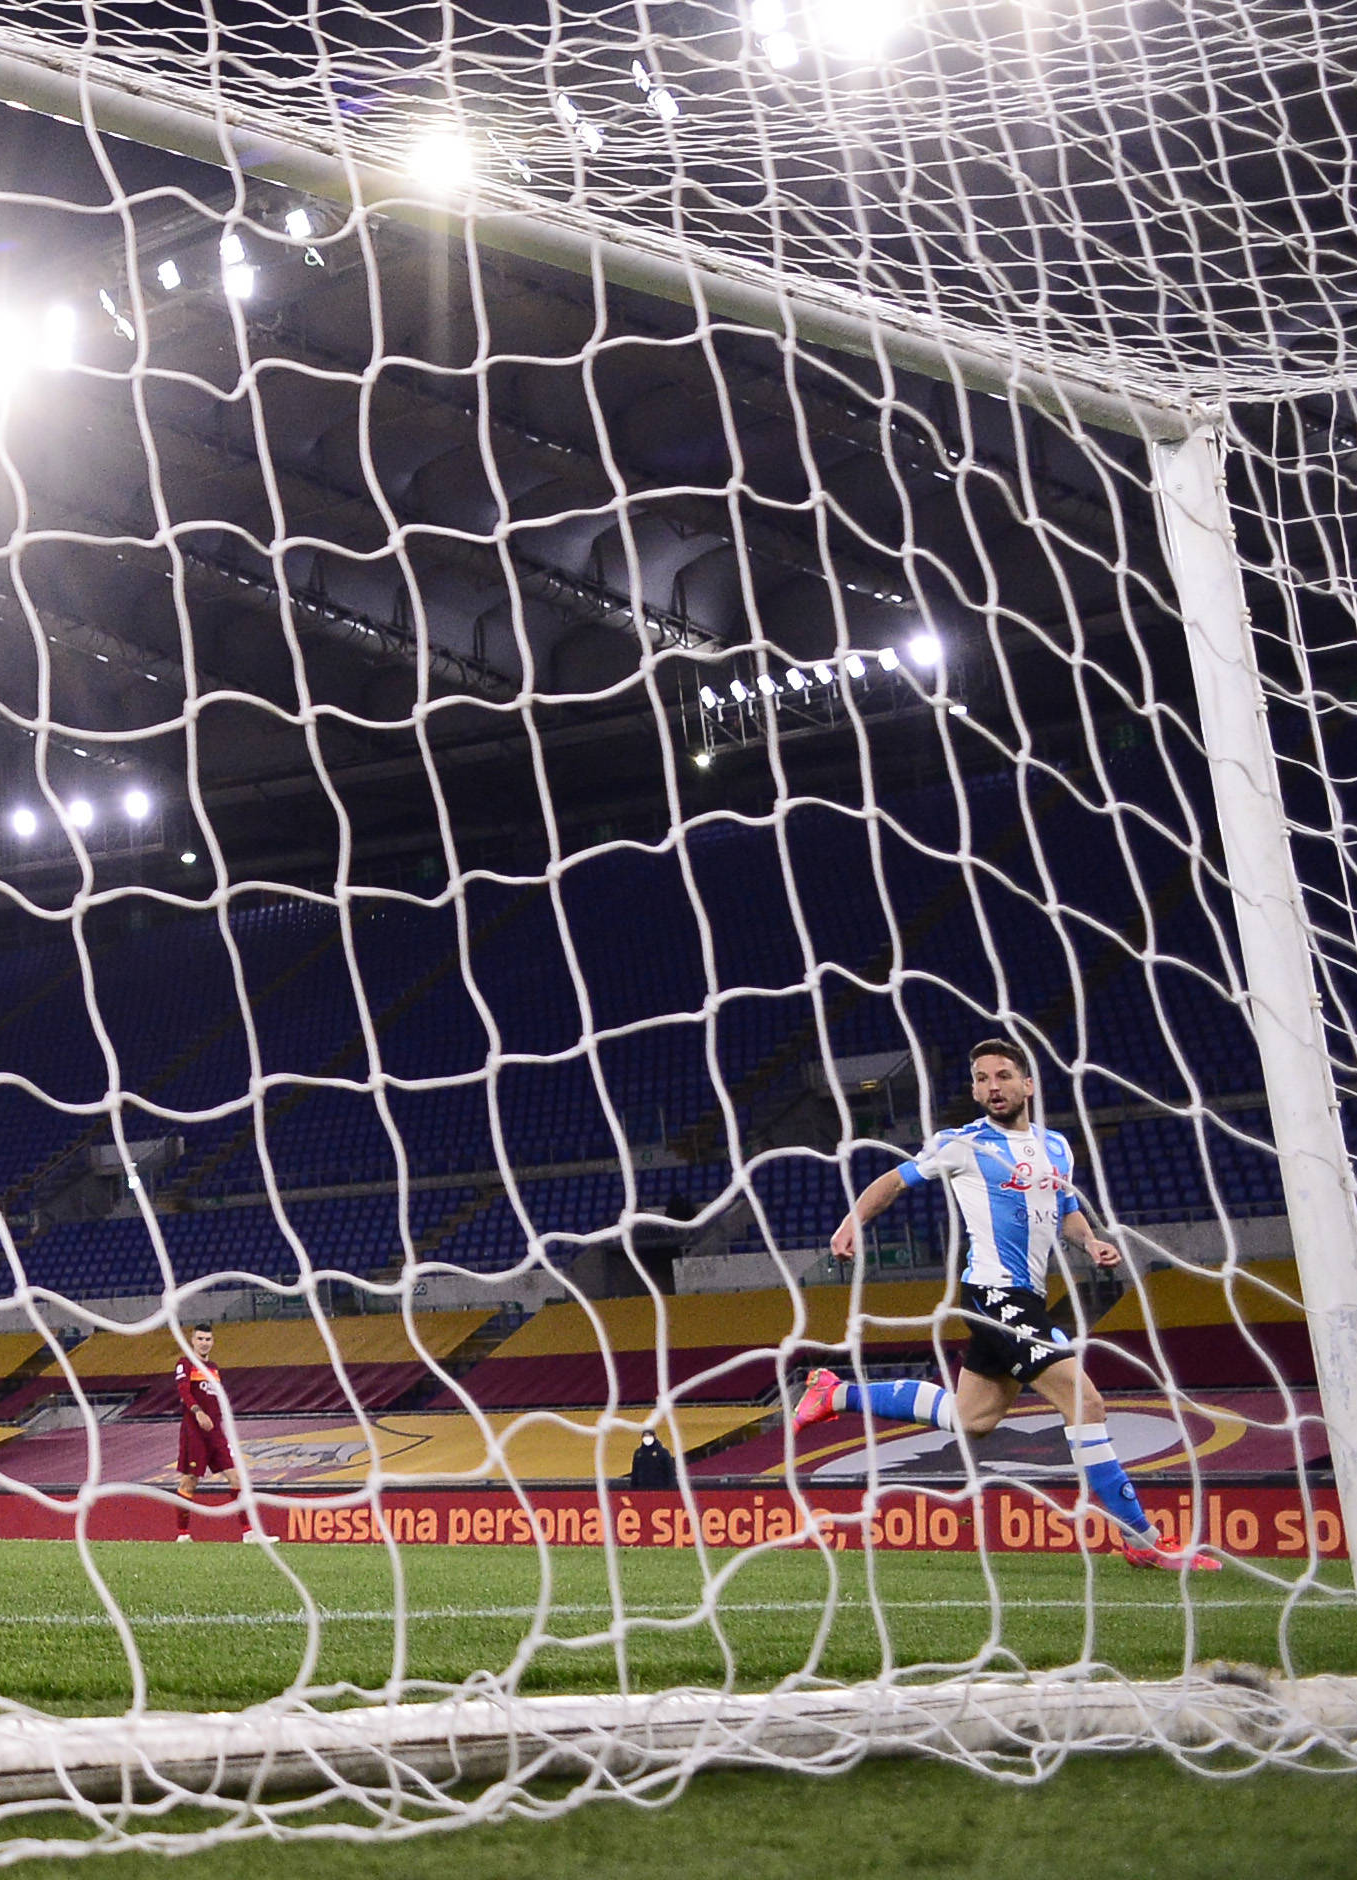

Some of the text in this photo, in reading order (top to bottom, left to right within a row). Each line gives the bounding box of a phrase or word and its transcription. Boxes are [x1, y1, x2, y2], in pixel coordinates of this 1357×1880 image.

[287, 1504, 438, 1542] Nessuna
[448, 1508, 606, 1545] persona
[617, 1496, 641, 1543] è
[651, 1495, 847, 1550] speciale,
[861, 1494, 959, 1546] solo
[1209, 1495, 1260, 1551] lo
[1274, 1510, 1348, 1552] so
